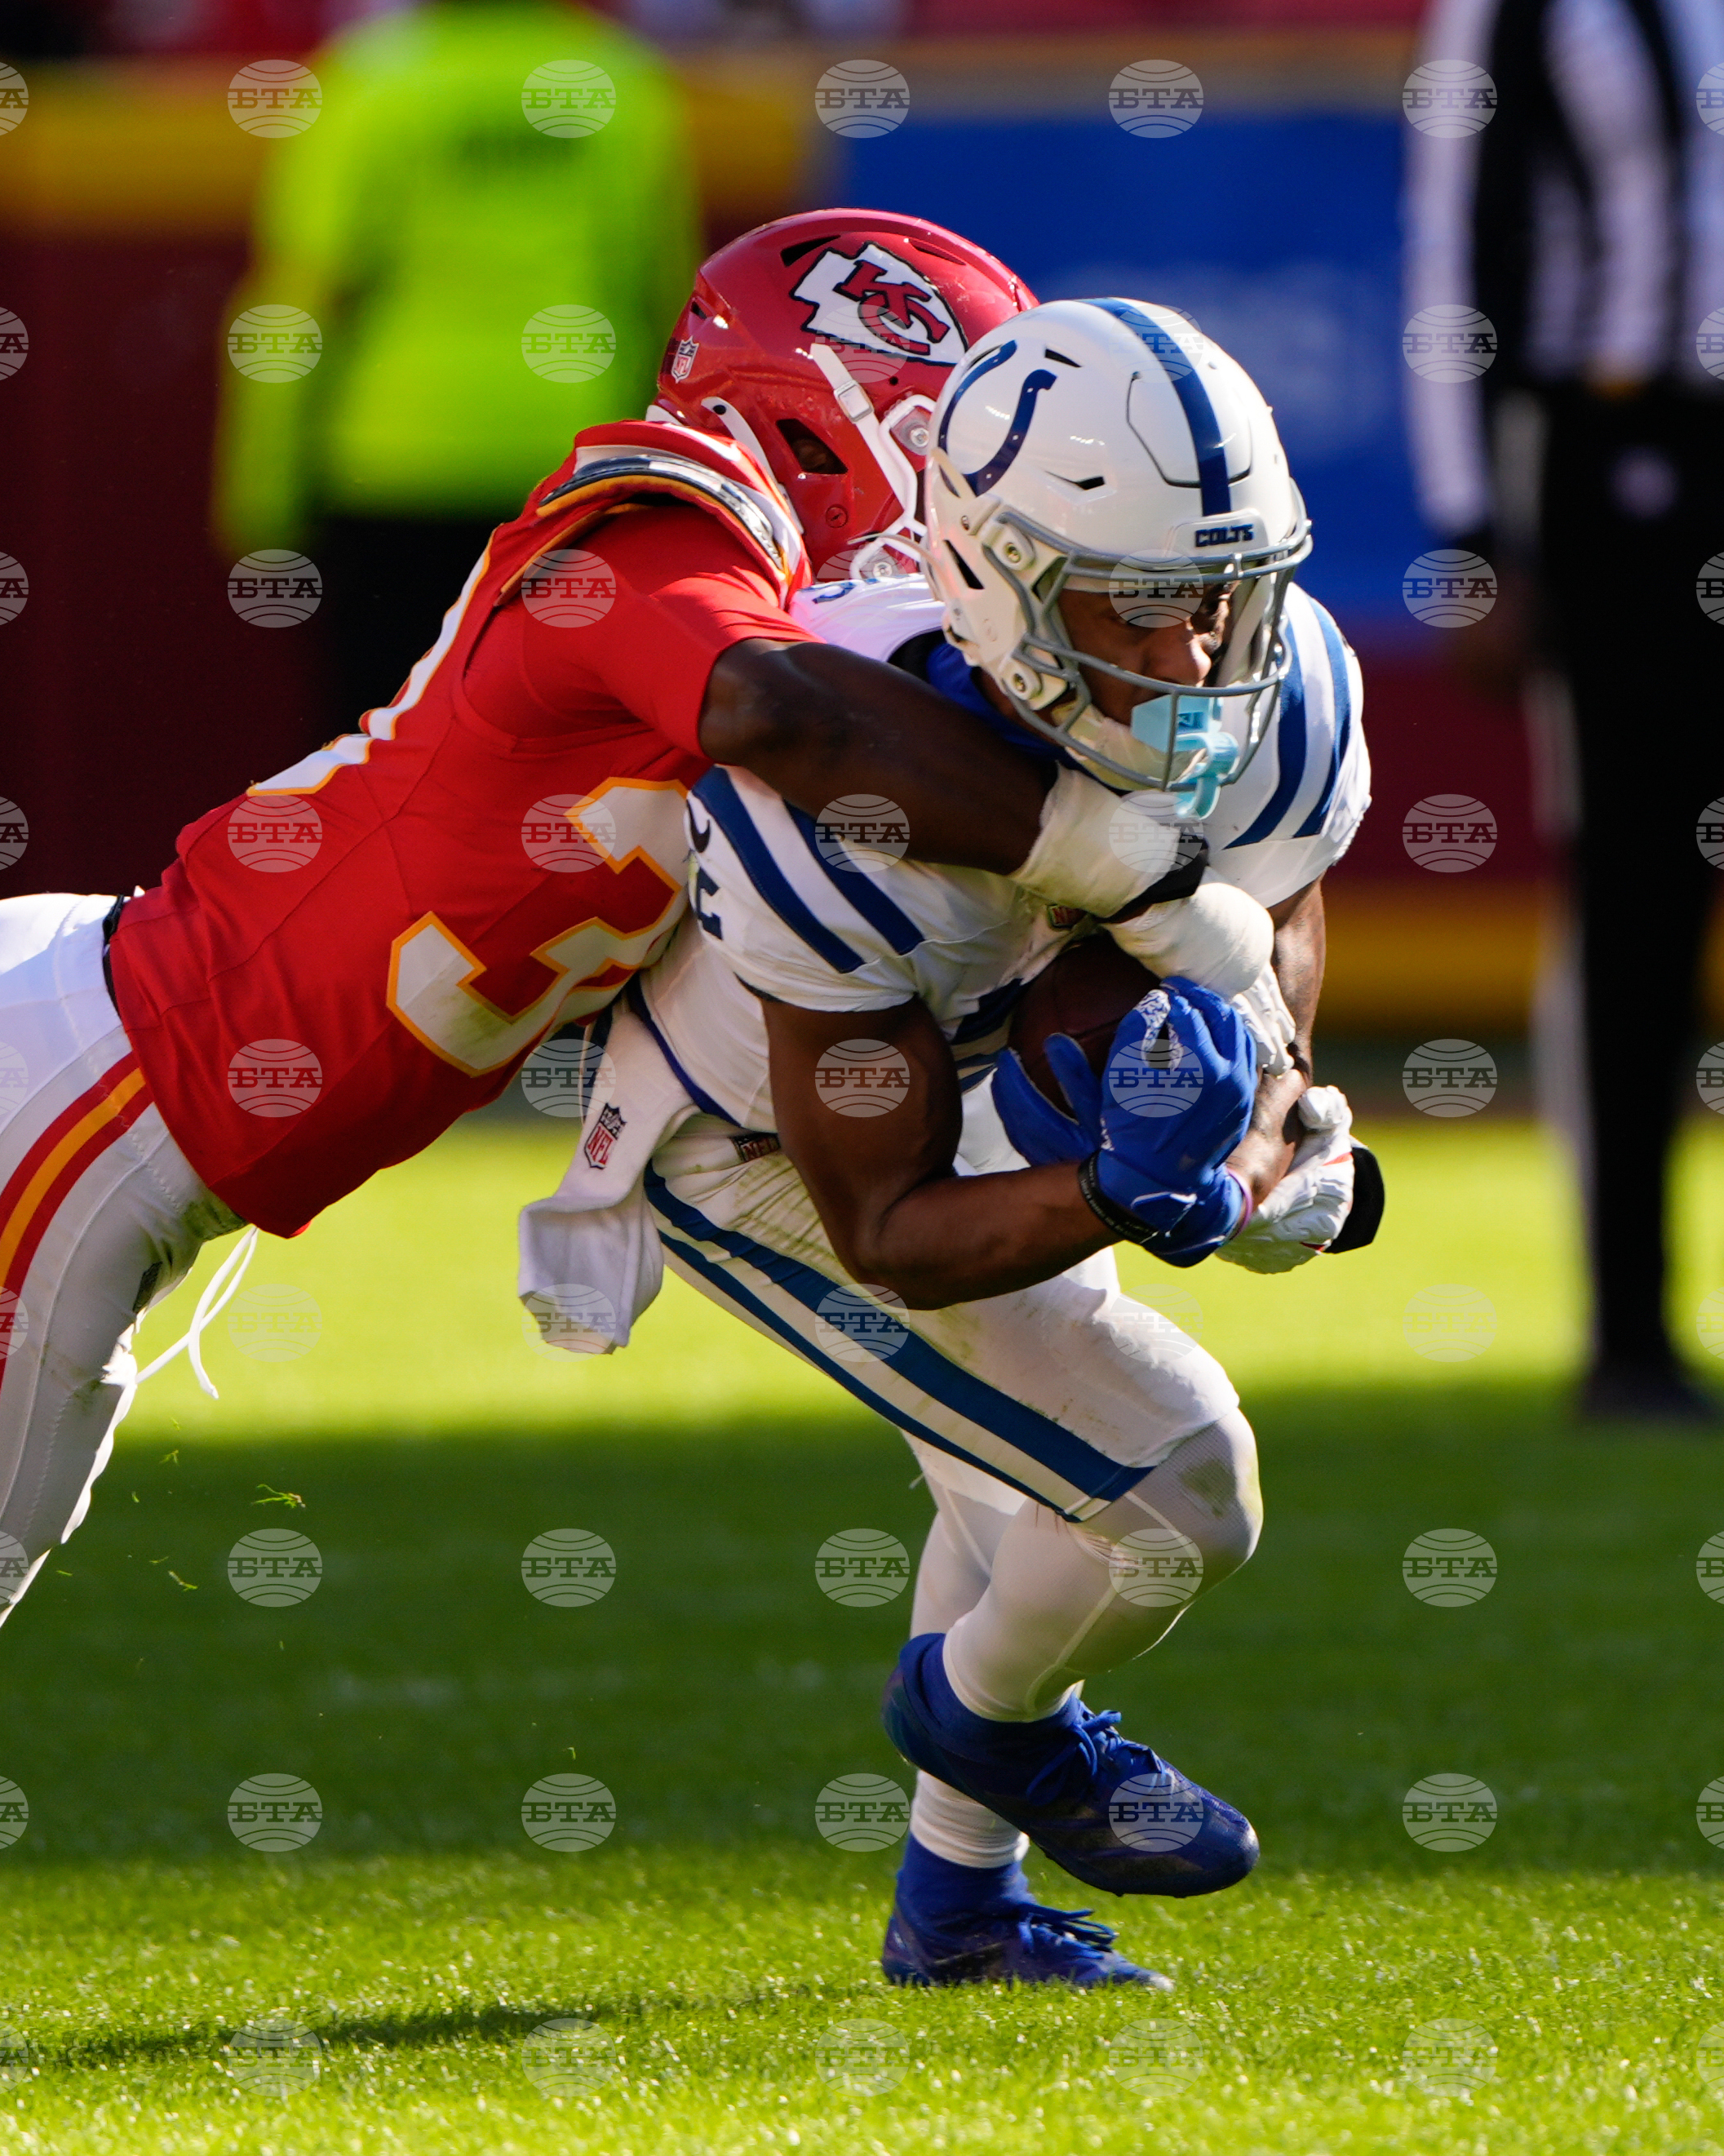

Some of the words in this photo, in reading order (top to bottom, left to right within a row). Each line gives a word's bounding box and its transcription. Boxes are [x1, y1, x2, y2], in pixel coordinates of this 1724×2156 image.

[832, 259, 951, 356] KC
[1194, 523, 1254, 548] COLTS
[587, 1125, 614, 1166] NFL
